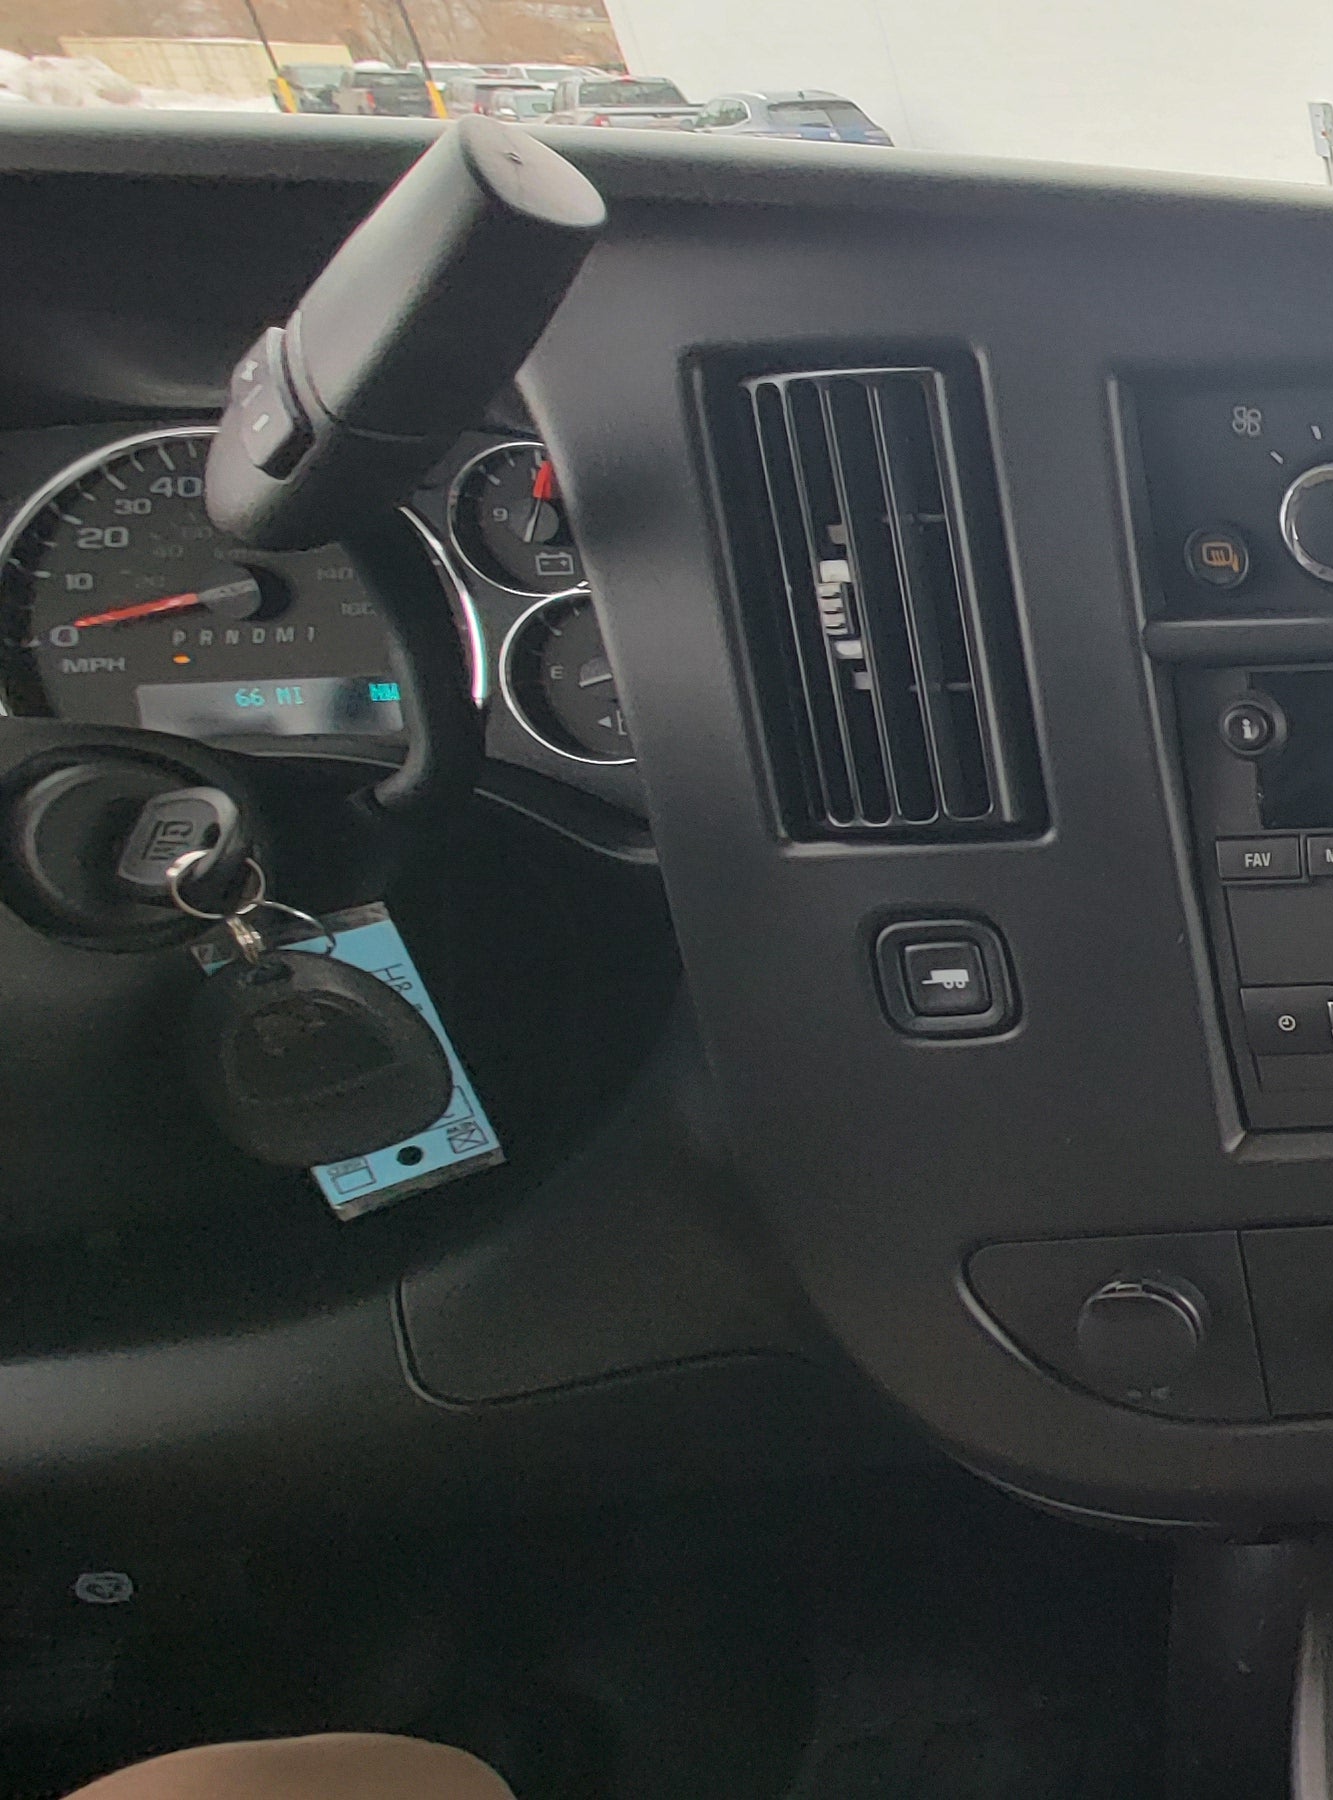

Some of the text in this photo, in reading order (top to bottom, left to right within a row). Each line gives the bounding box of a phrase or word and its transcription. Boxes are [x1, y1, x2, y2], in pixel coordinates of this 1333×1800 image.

[150, 476, 202, 498] 40
[114, 498, 152, 516] 30
[493, 507, 508, 522] 9
[77, 526, 130, 549] 20
[64, 572, 94, 591] 10
[50, 624, 80, 648] 0
[62, 657, 126, 674] MPH
[550, 666, 563, 681] E
[234, 685, 305, 708] 66 MI
[1244, 853, 1271, 868] FAV
